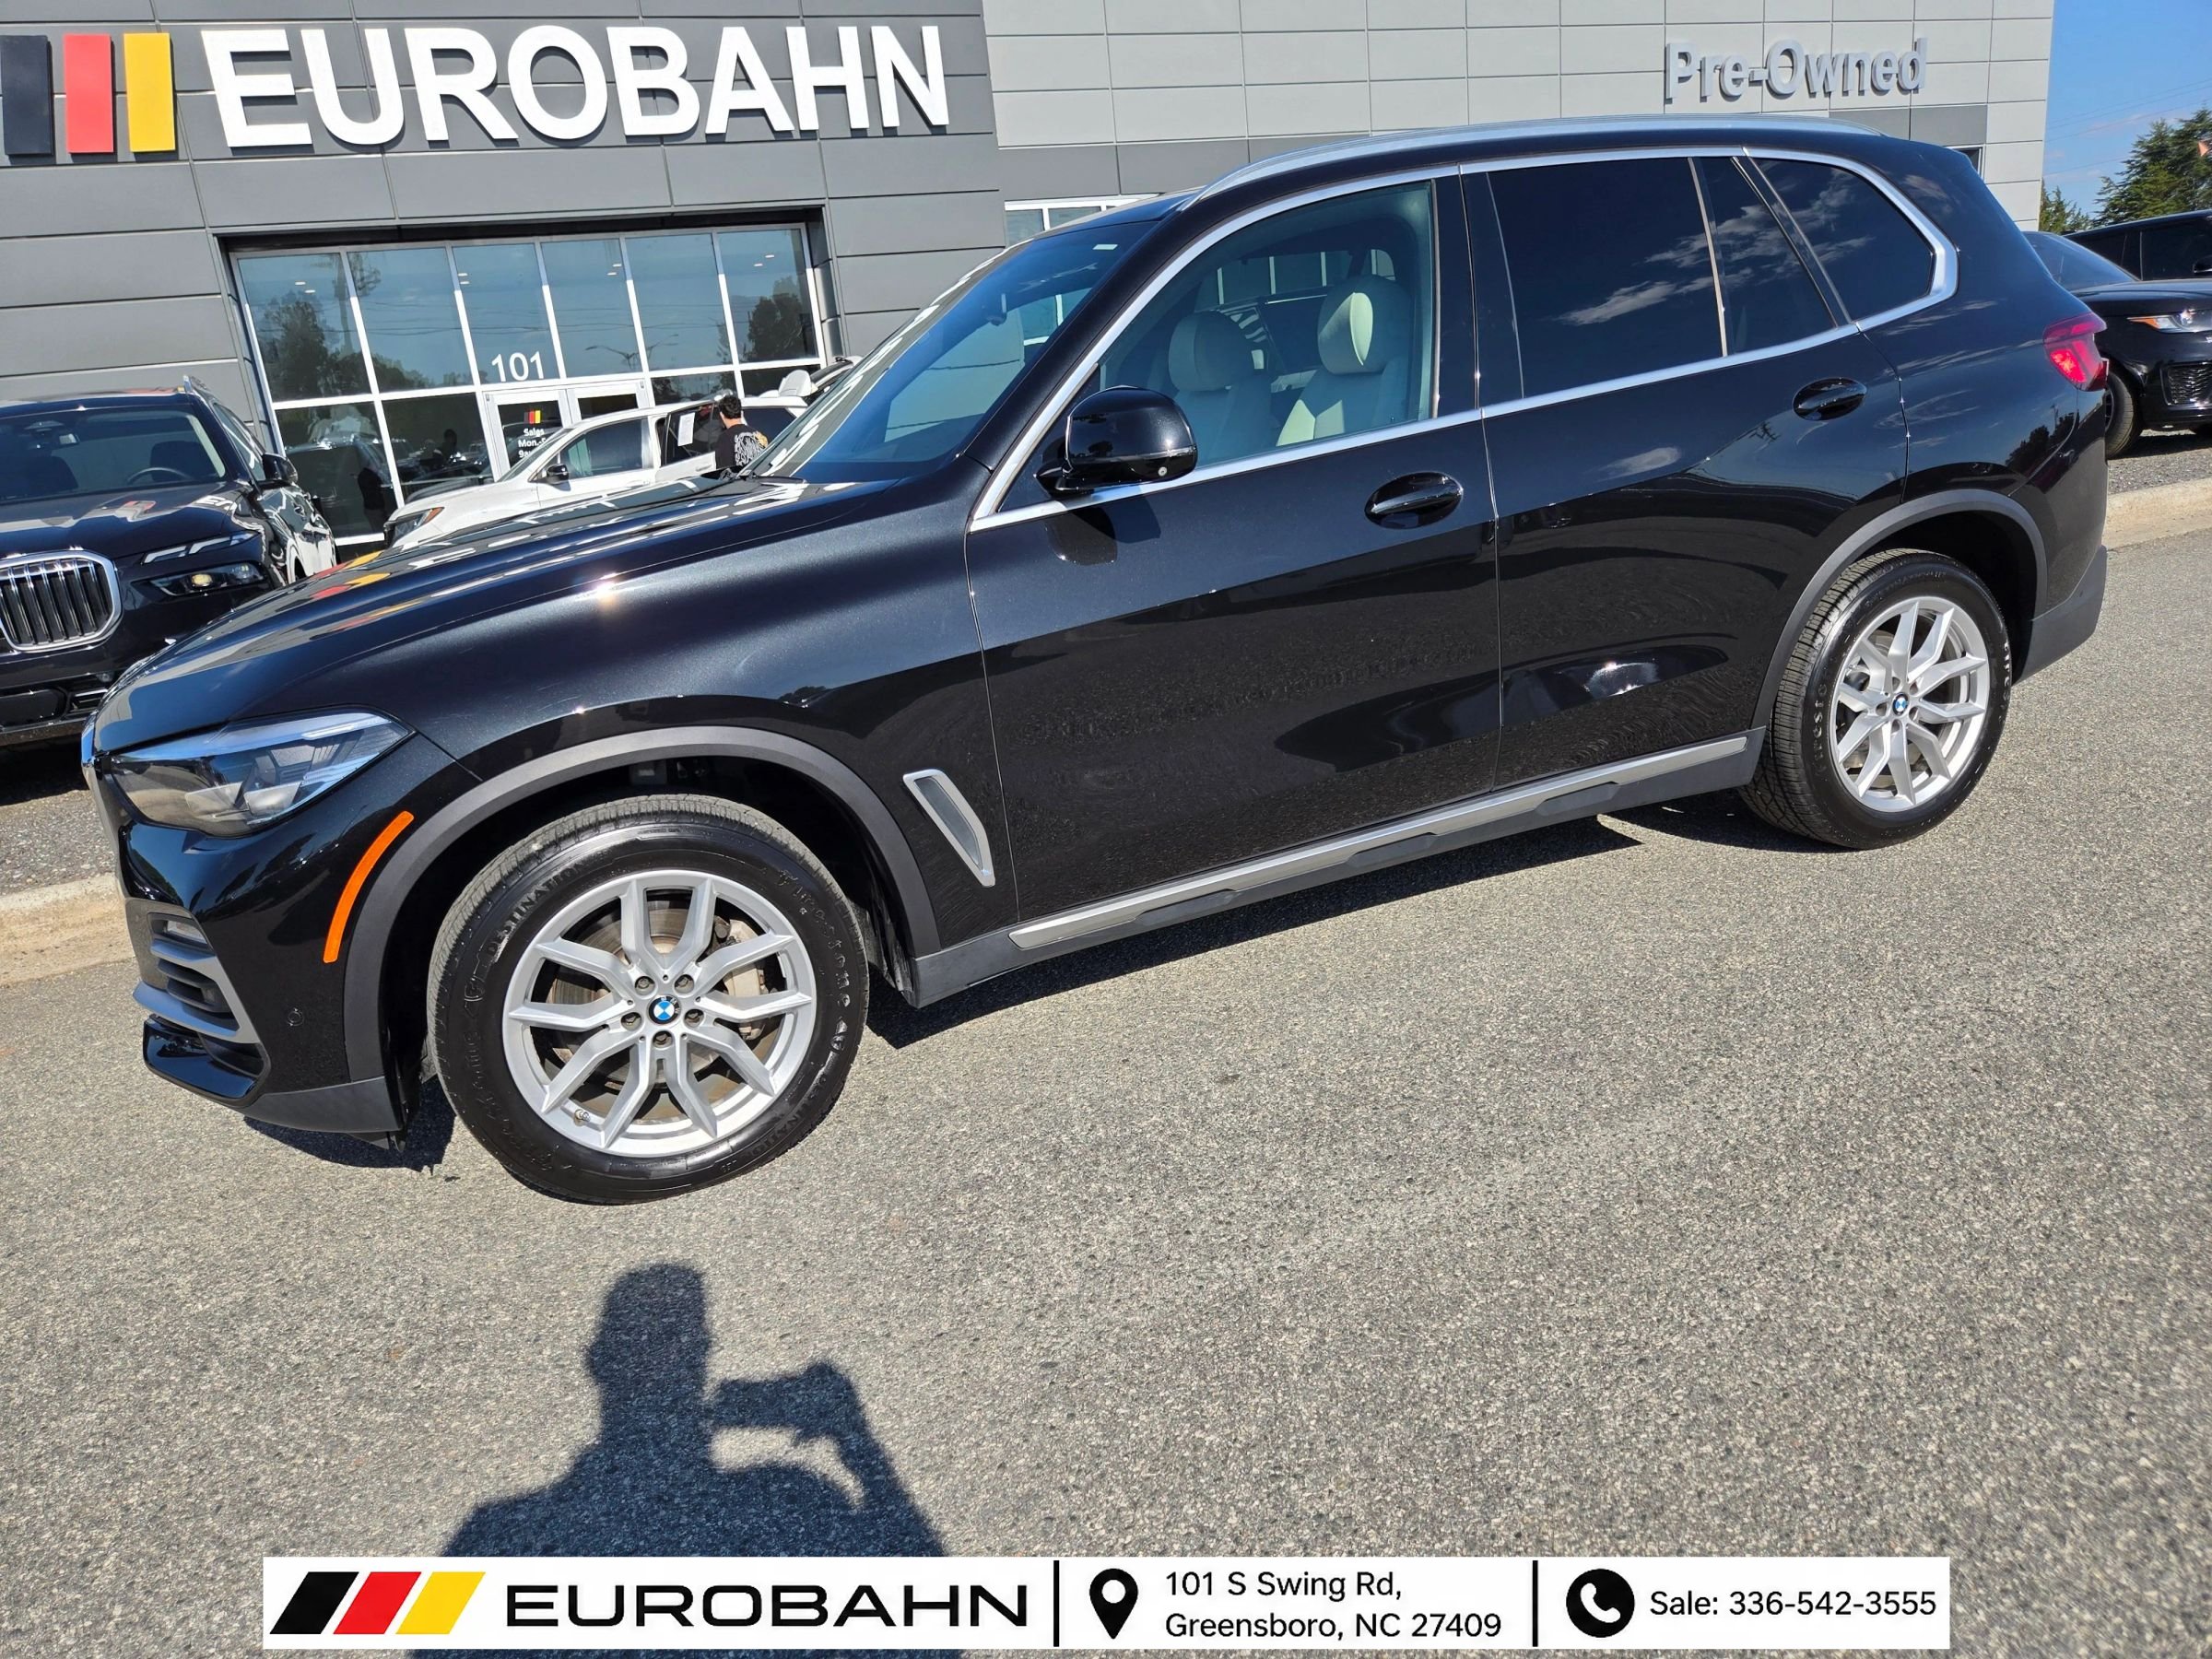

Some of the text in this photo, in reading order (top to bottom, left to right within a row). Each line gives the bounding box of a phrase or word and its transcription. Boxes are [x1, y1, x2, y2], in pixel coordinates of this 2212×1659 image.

[200, 25, 949, 149] EUROBAHN
[1665, 37, 1928, 103] Pre-Owned
[491, 351, 545, 382] 101
[523, 427, 545, 438] Sales
